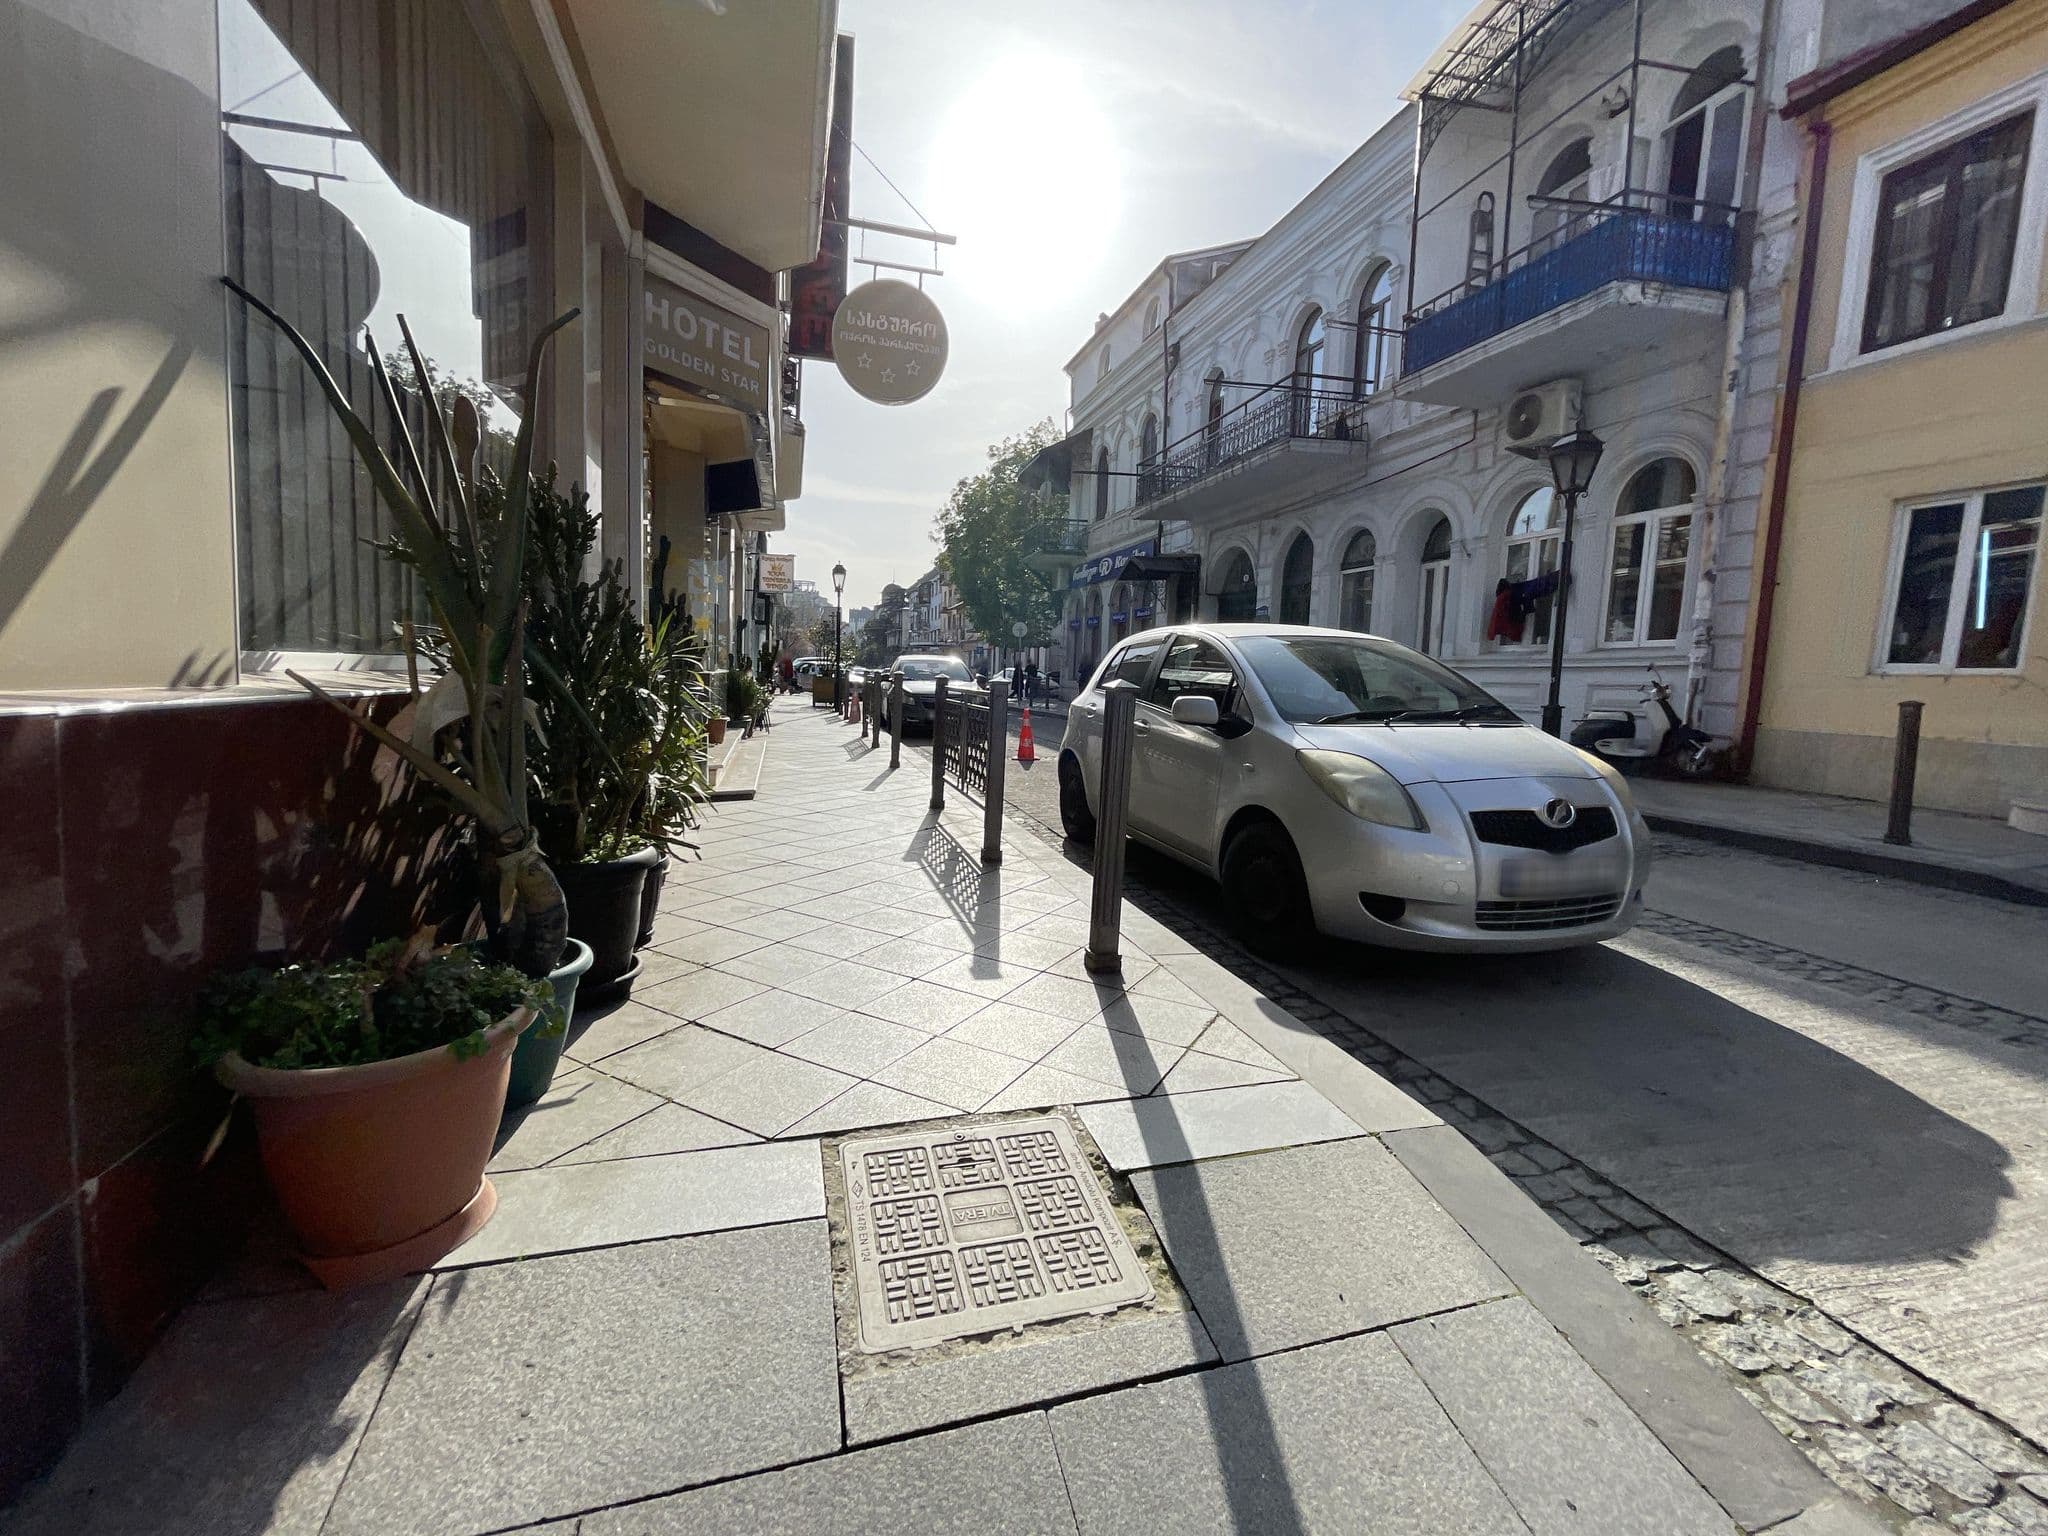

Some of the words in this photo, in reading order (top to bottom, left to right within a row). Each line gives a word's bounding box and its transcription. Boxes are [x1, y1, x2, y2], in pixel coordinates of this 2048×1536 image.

[644, 291, 760, 371] HOTEL
[846, 309, 937, 339] სასტუმრო
[644, 338, 715, 377] GOLDEN
[720, 369, 760, 394] STAR
[955, 1207, 987, 1221] ERA
[990, 1204, 1011, 1216] TV
